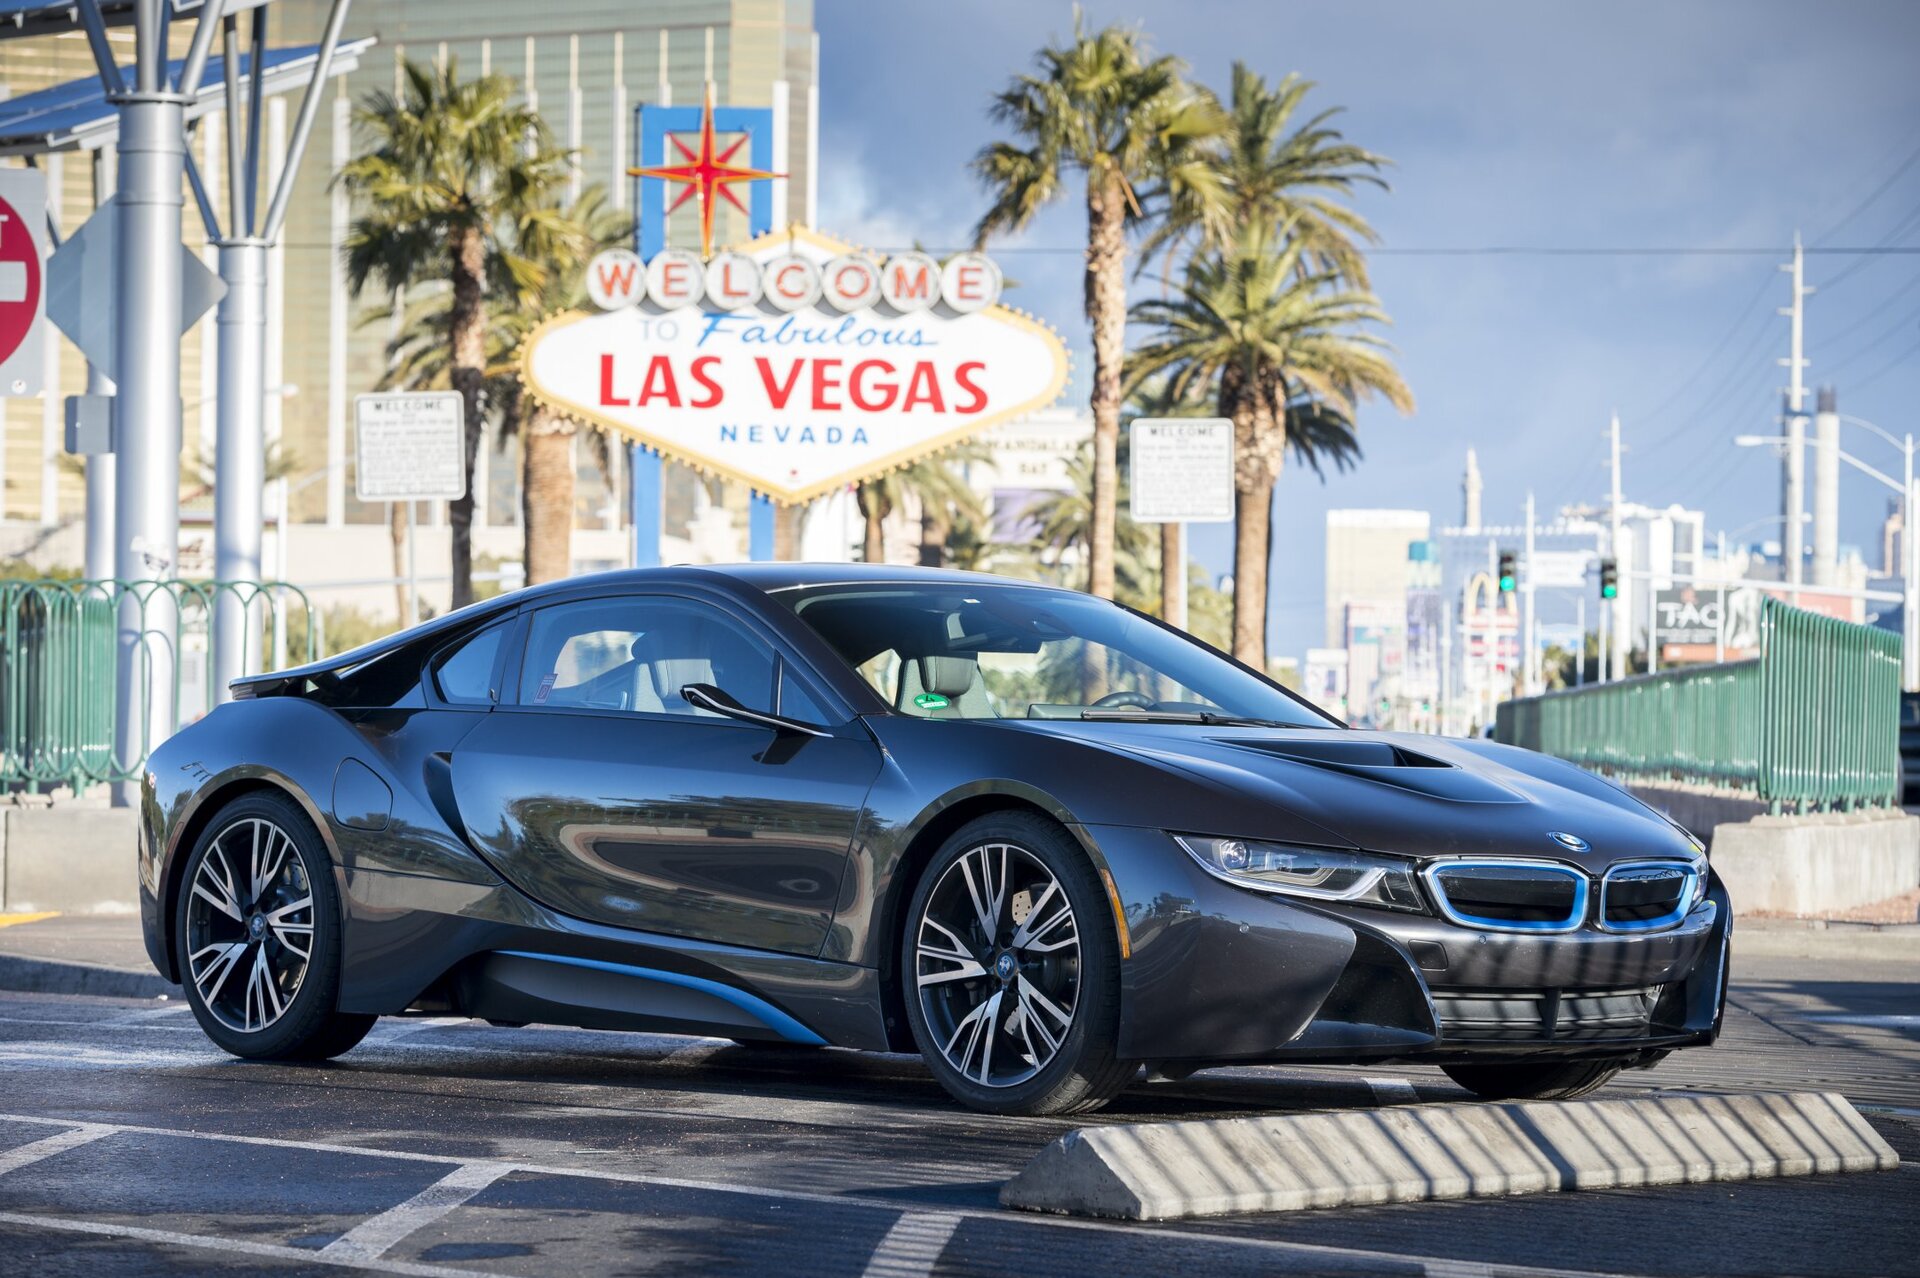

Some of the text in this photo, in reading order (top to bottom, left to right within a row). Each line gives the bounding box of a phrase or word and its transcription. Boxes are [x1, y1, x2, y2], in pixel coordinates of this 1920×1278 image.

[597, 262, 983, 299] WELCOME
[641, 312, 939, 348] TO Fabulous
[600, 354, 989, 414] LAS VEGAS
[374, 400, 442, 411] WELCOME
[720, 424, 870, 446] NEVADA
